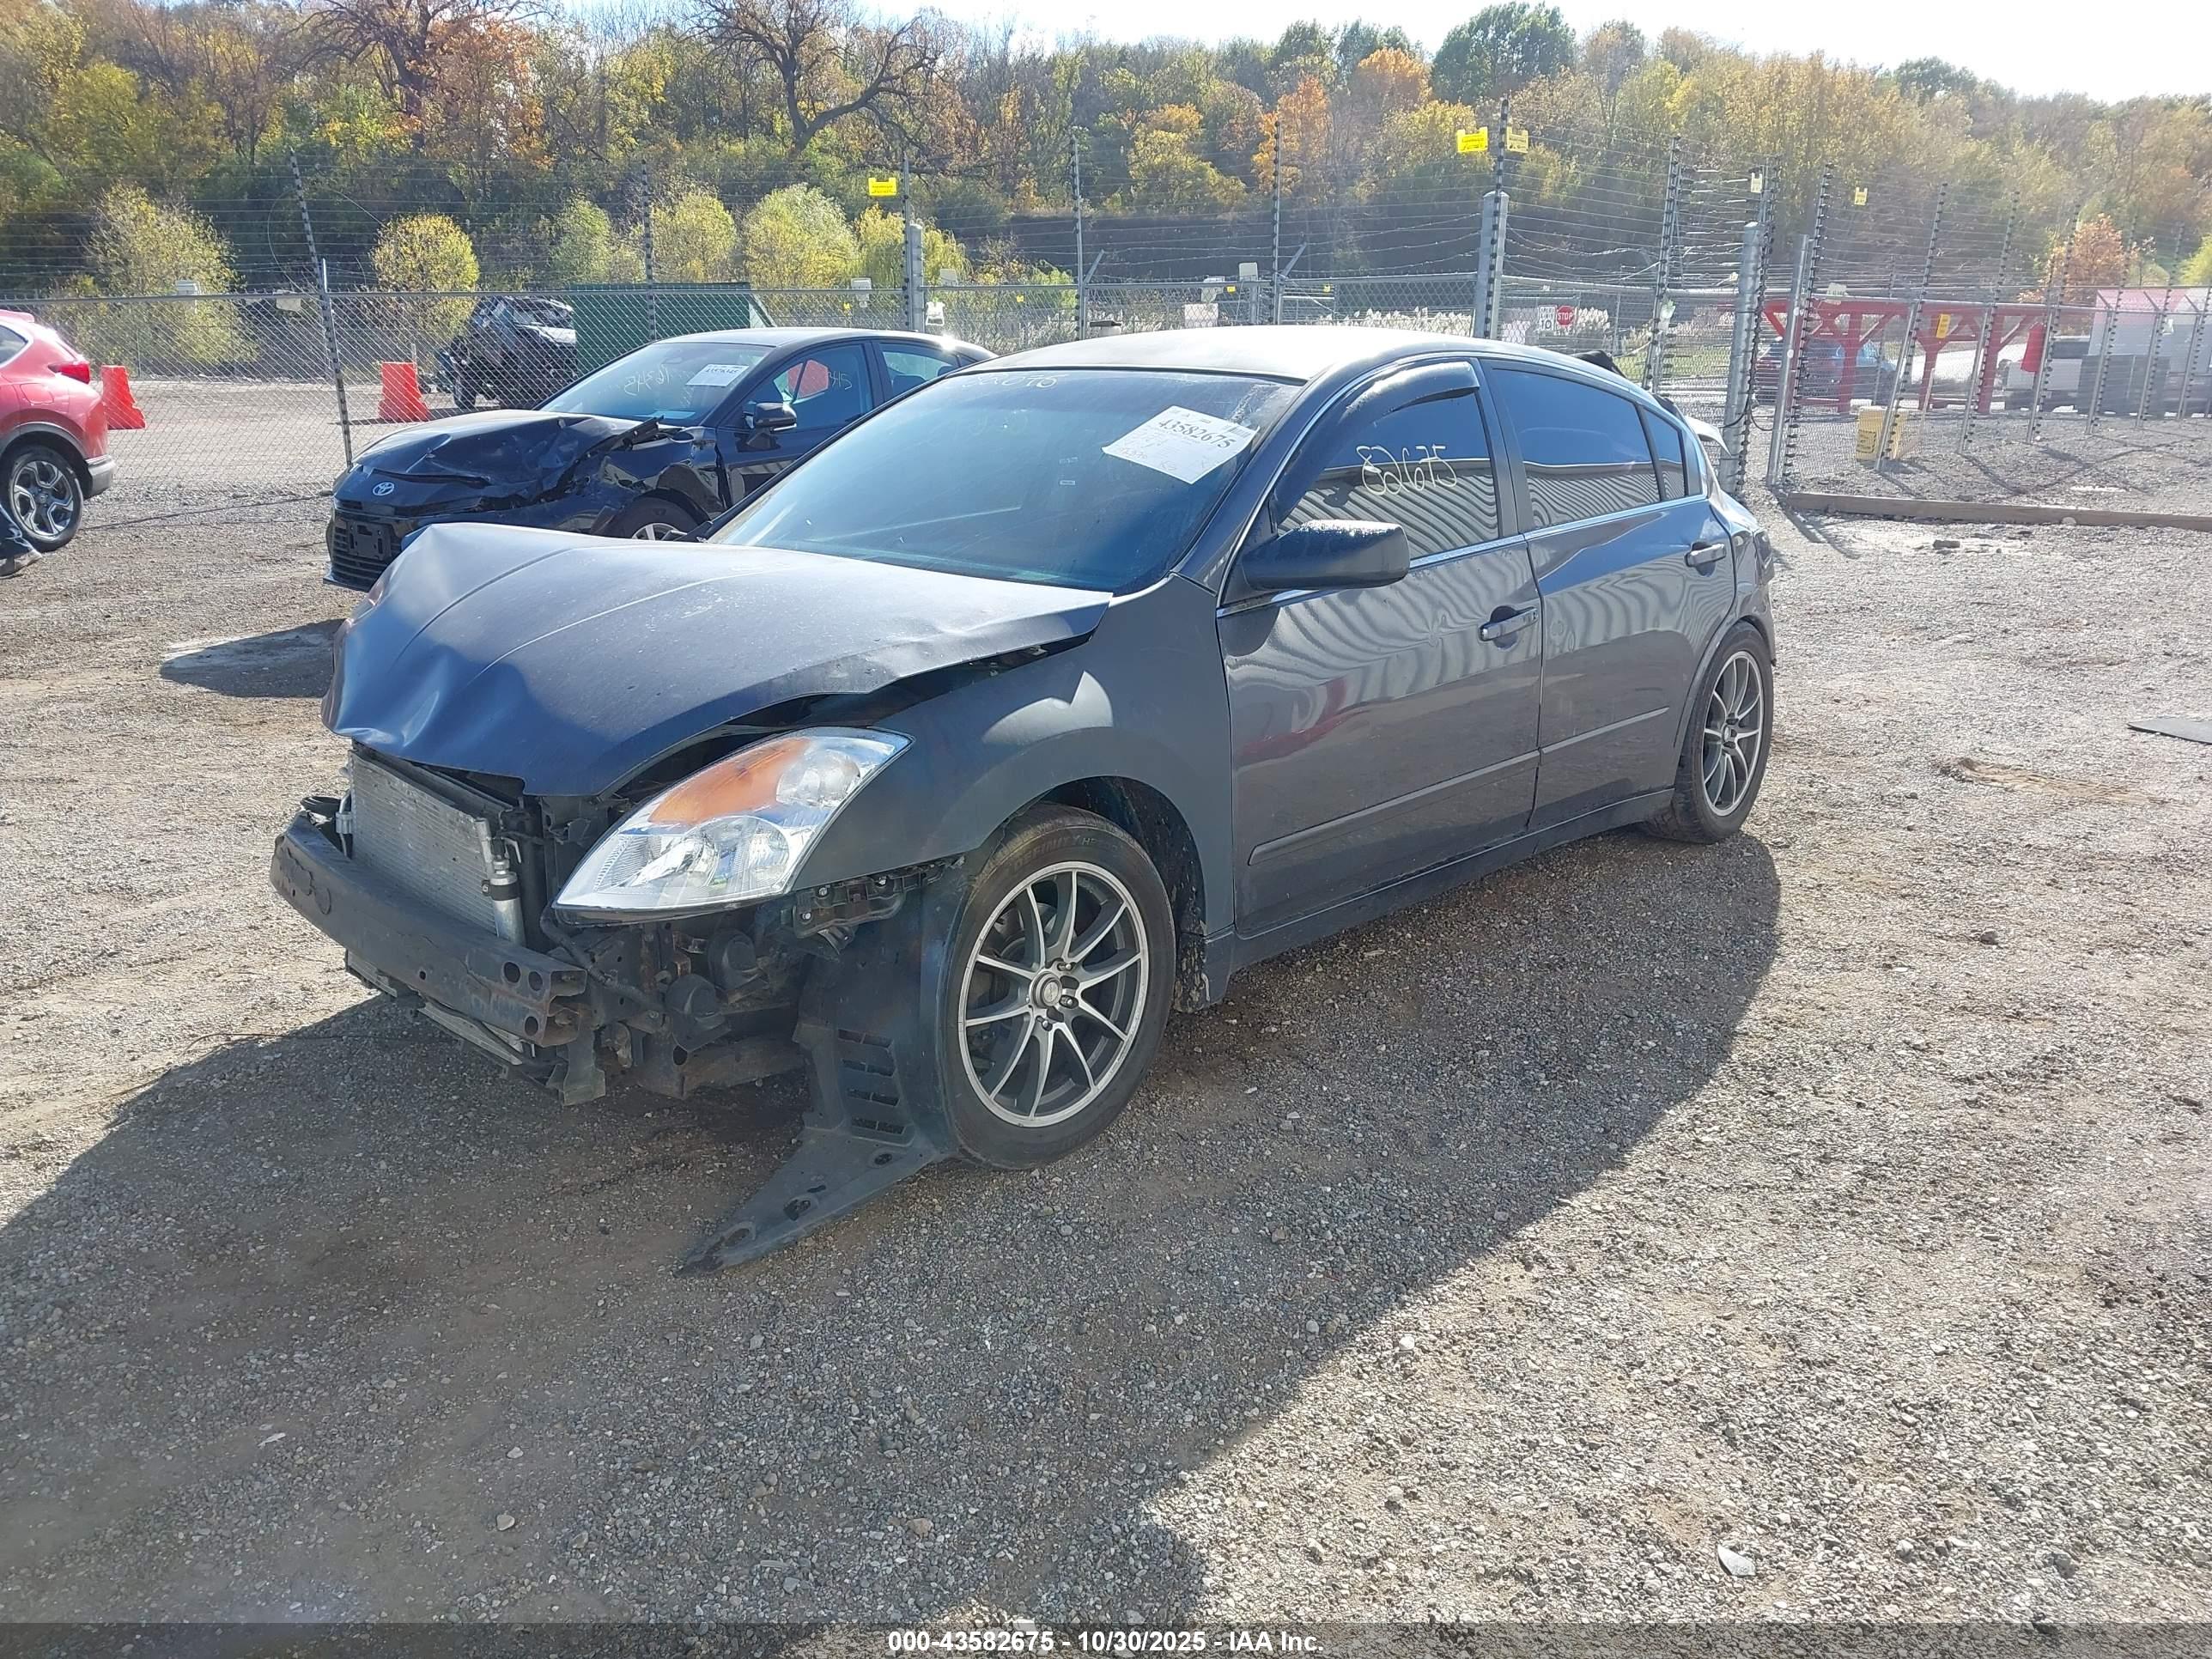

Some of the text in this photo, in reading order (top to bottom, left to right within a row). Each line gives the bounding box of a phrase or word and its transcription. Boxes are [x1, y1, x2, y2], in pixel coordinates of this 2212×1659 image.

[1541, 319, 1552, 330] 10
[1558, 312, 1573, 320] STOP
[1158, 418, 1237, 448] 43582675
[1357, 443, 1457, 495] 82675
